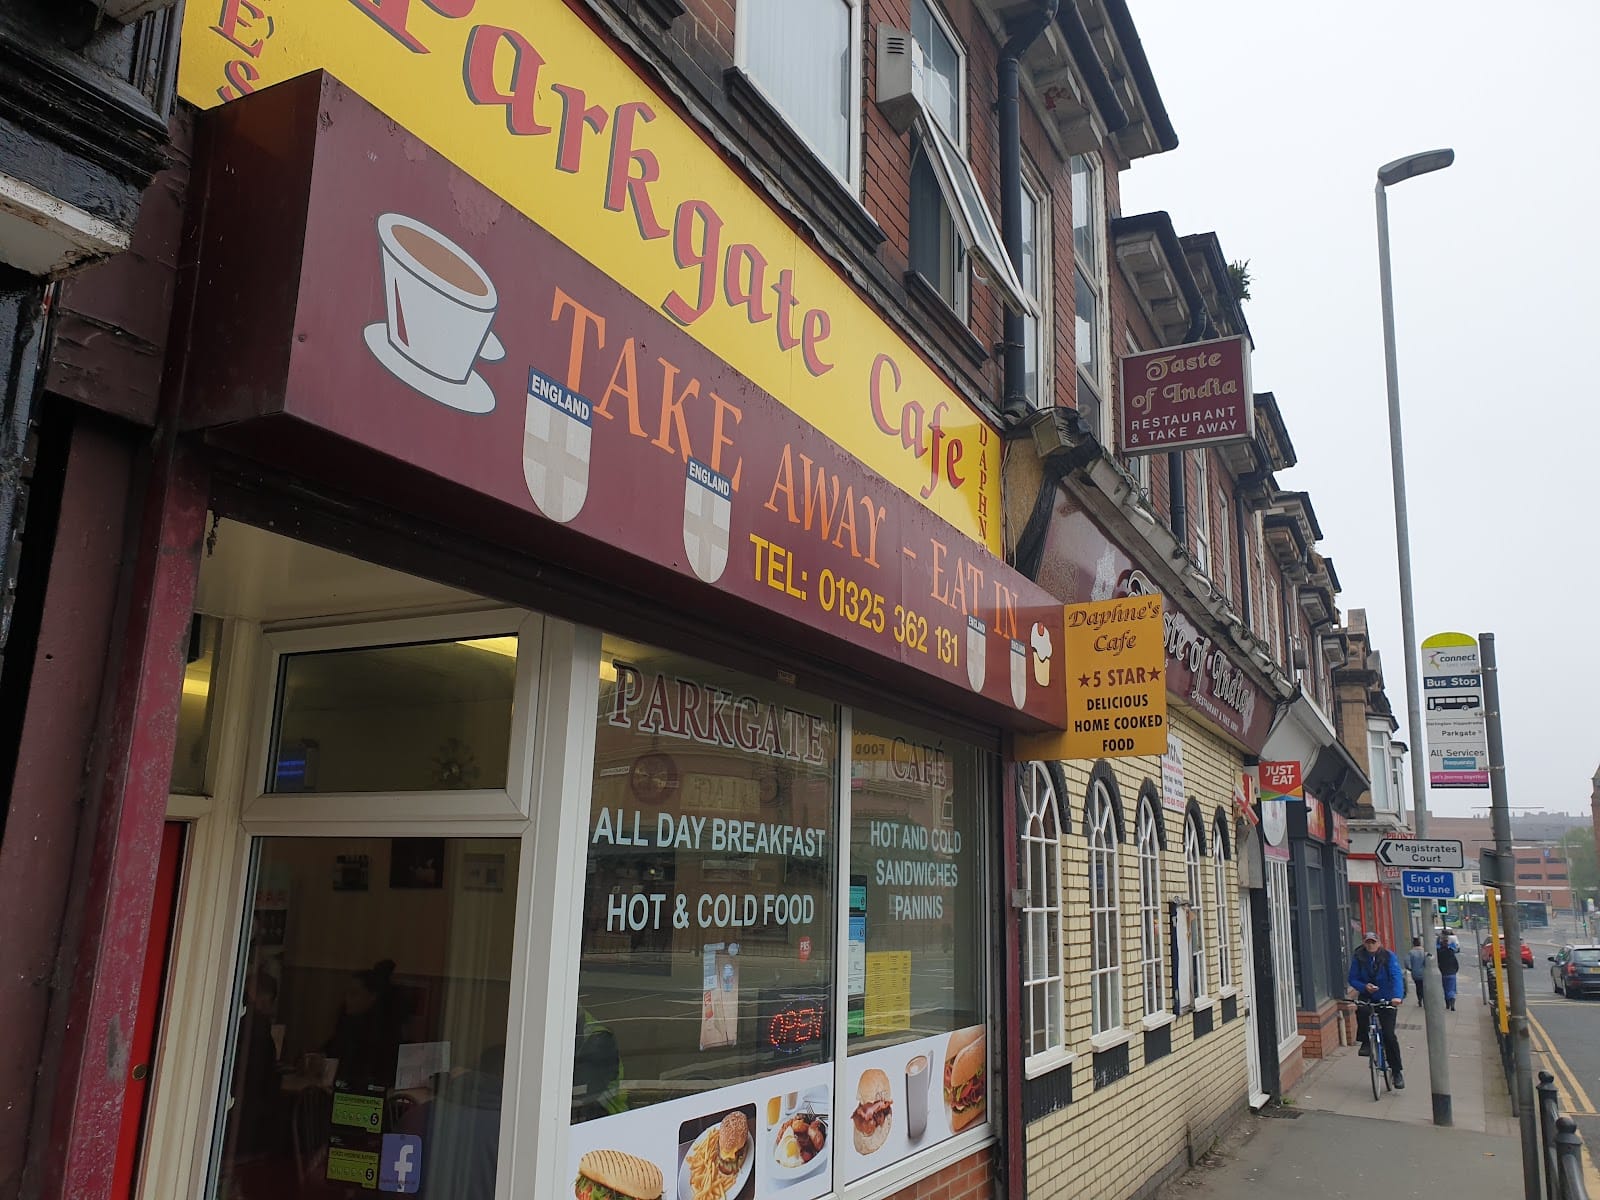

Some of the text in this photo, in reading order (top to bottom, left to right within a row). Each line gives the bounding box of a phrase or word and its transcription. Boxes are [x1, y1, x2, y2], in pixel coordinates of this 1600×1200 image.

[1146, 352, 1221, 381] Taste
[531, 374, 590, 421] ENGLAND
[1131, 377, 1237, 415] of India
[869, 352, 966, 500] Cafe
[1131, 406, 1236, 430] RESTAURANT
[1130, 420, 1237, 444] & TAKE AWAY
[550, 285, 743, 493] TAKE
[763, 442, 887, 569] AWAY
[930, 538, 984, 618] EAT
[993, 580, 1019, 639] IN
[689, 461, 730, 496] ENGLAND
[749, 533, 959, 667] TEL: 01325 362 131
[1068, 601, 1161, 631] Daphne's
[1093, 629, 1137, 657] Cafe
[1440, 653, 1477, 663] connect
[1093, 667, 1146, 688] 5 STAR
[1426, 677, 1477, 688] Bus Stop
[609, 658, 824, 765] PARKGATE
[1087, 694, 1149, 711] DELICIOUS
[1074, 714, 1163, 733] HOME COOKED
[1102, 738, 1135, 752] FOOD
[1446, 749, 1485, 757] Services
[890, 736, 946, 789] CAFÉ
[1265, 764, 1295, 777] JUST
[1271, 774, 1296, 786] EAT
[591, 807, 826, 858] ALL DAY BREAKFAST
[870, 821, 962, 854] HOT AND COLD
[1395, 843, 1457, 854] Magistrates
[1411, 854, 1441, 863] Court
[875, 858, 958, 887] SANDWICHES
[1410, 874, 1445, 883] End of
[1406, 884, 1451, 894] bus lane
[606, 892, 667, 932] HOT
[672, 892, 690, 929] &
[697, 893, 758, 929] COLD
[763, 893, 814, 925] FOOD
[895, 895, 944, 921] PANINIS
